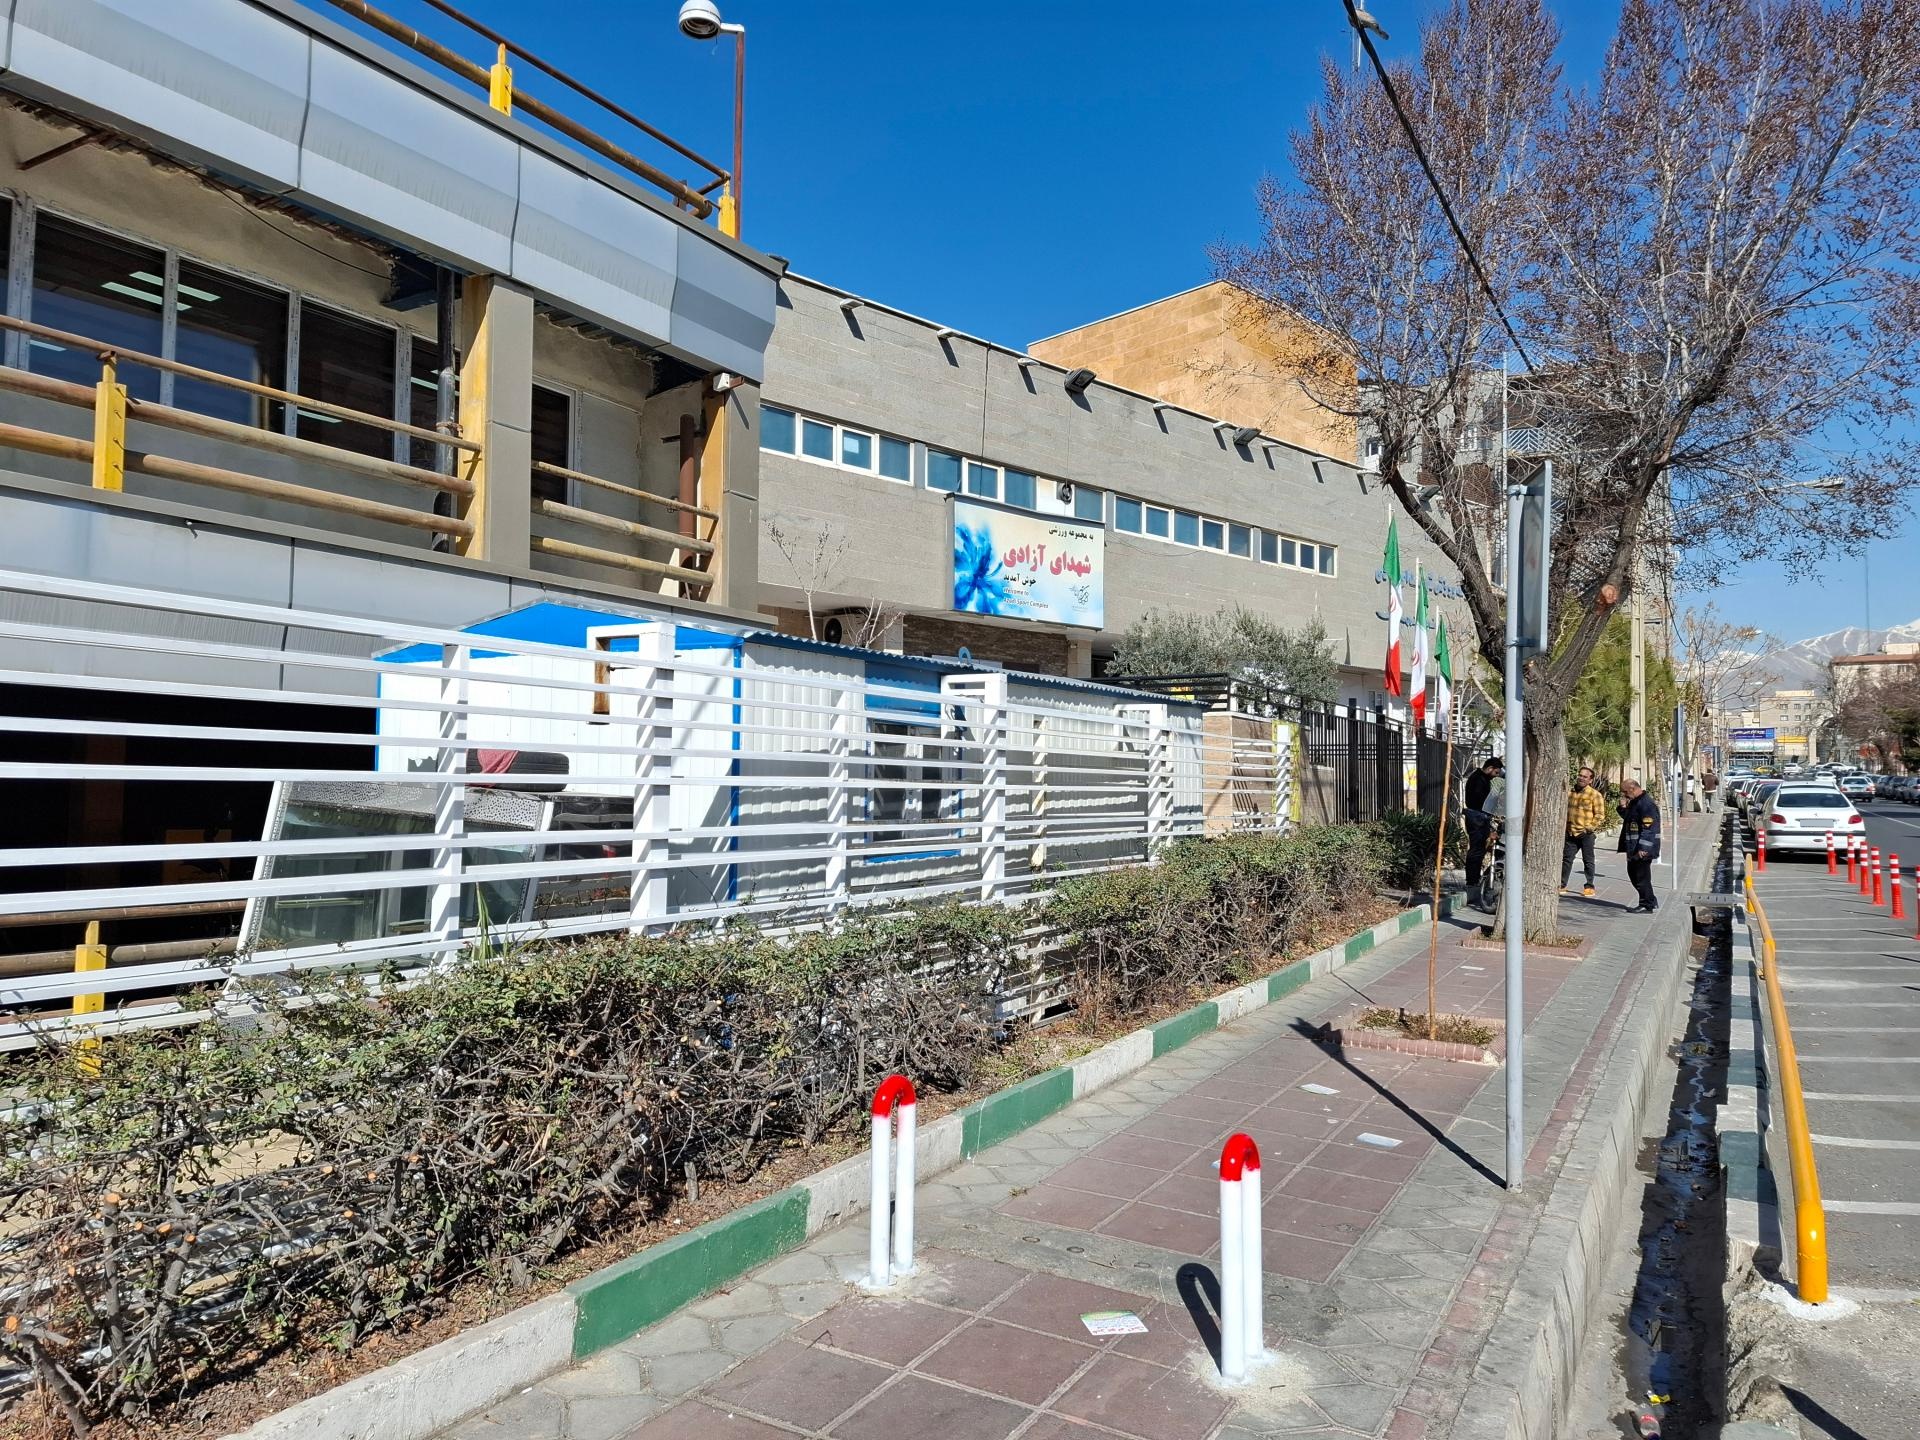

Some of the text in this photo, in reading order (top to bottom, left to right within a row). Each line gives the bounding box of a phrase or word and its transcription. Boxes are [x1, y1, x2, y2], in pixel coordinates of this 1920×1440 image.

[1049, 526, 1067, 538] ورزشی
[1068, 530, 1088, 541] مجموعه
[1004, 544, 1091, 577] شهدای آزادی
[1003, 573, 1036, 587] خوش آمدید
[1003, 587, 1023, 595] Welcome
[1029, 601, 1048, 609] Complex
